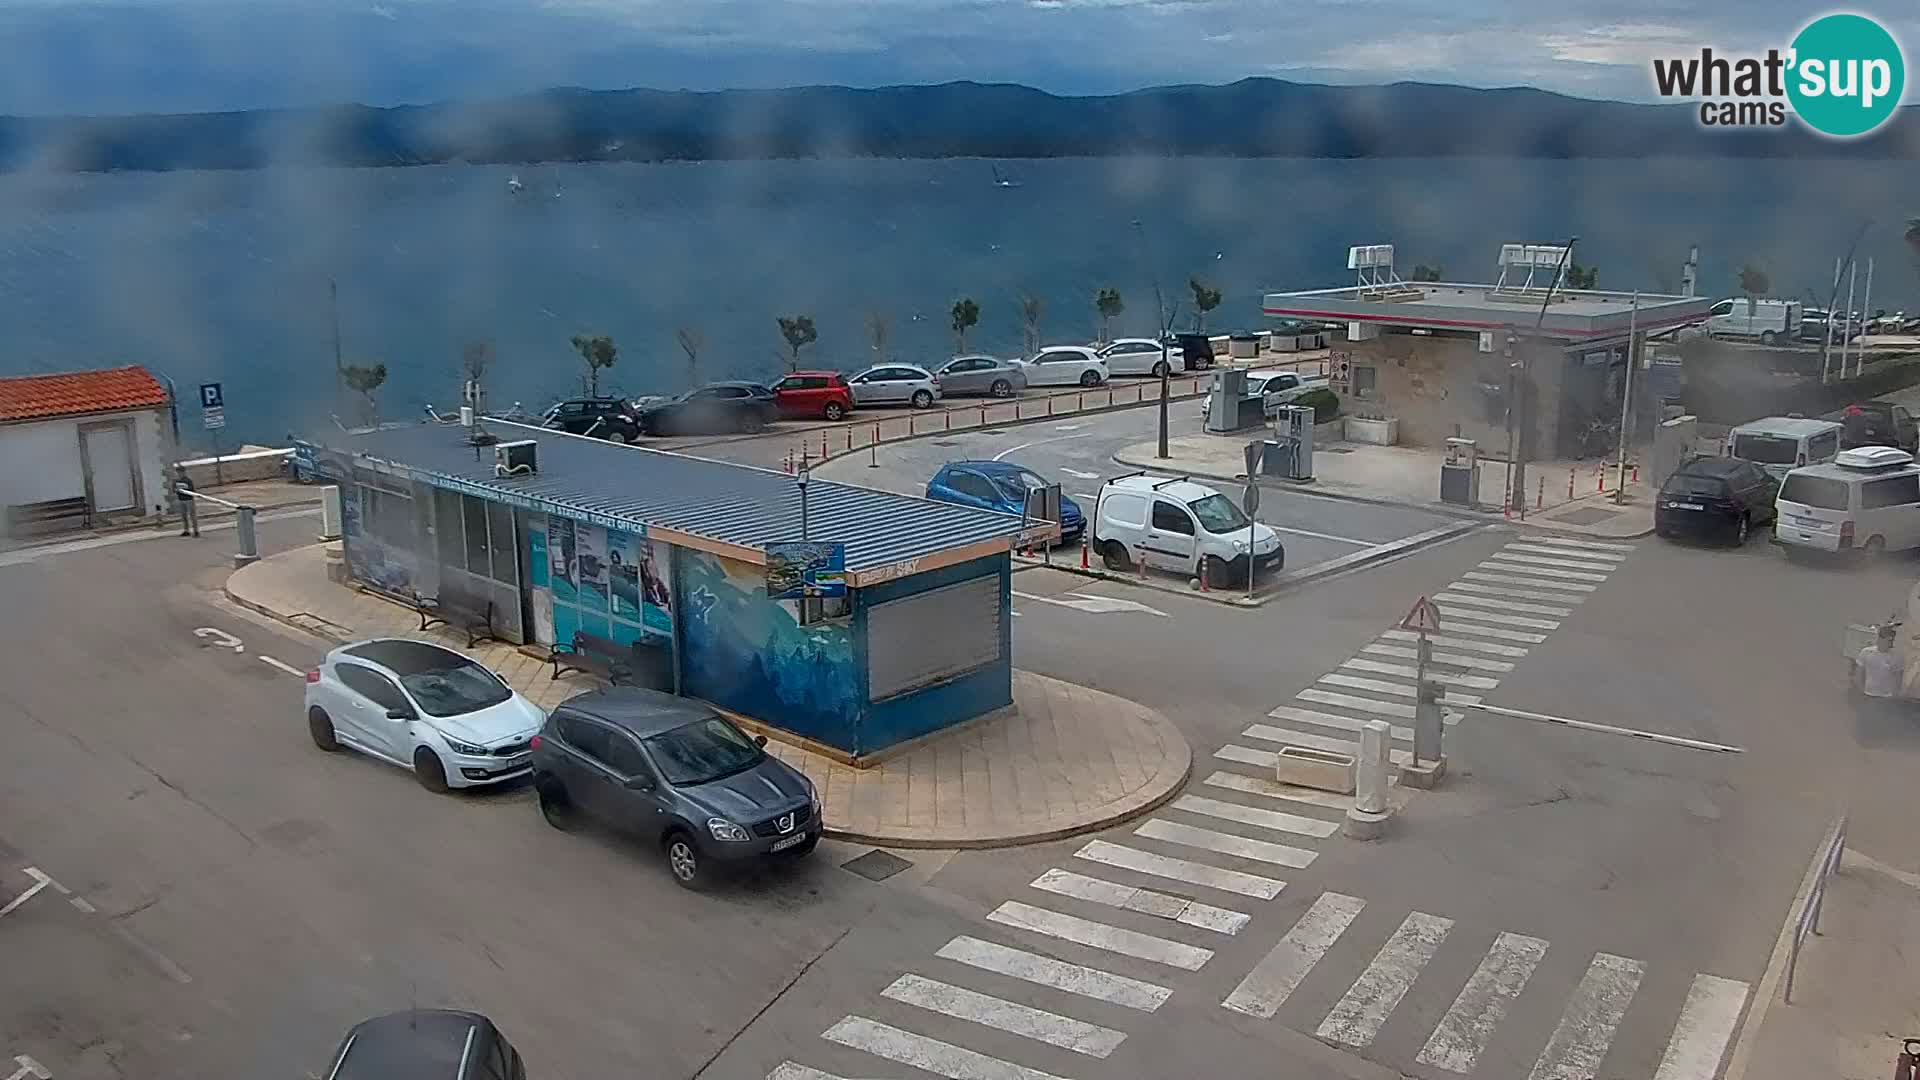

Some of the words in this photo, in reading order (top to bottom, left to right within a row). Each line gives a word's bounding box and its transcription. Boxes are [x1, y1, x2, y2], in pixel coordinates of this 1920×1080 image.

[205, 387, 217, 404] P
[557, 505, 588, 521] STATION
[590, 513, 617, 528] TICKET
[617, 518, 644, 534] OFFICE
